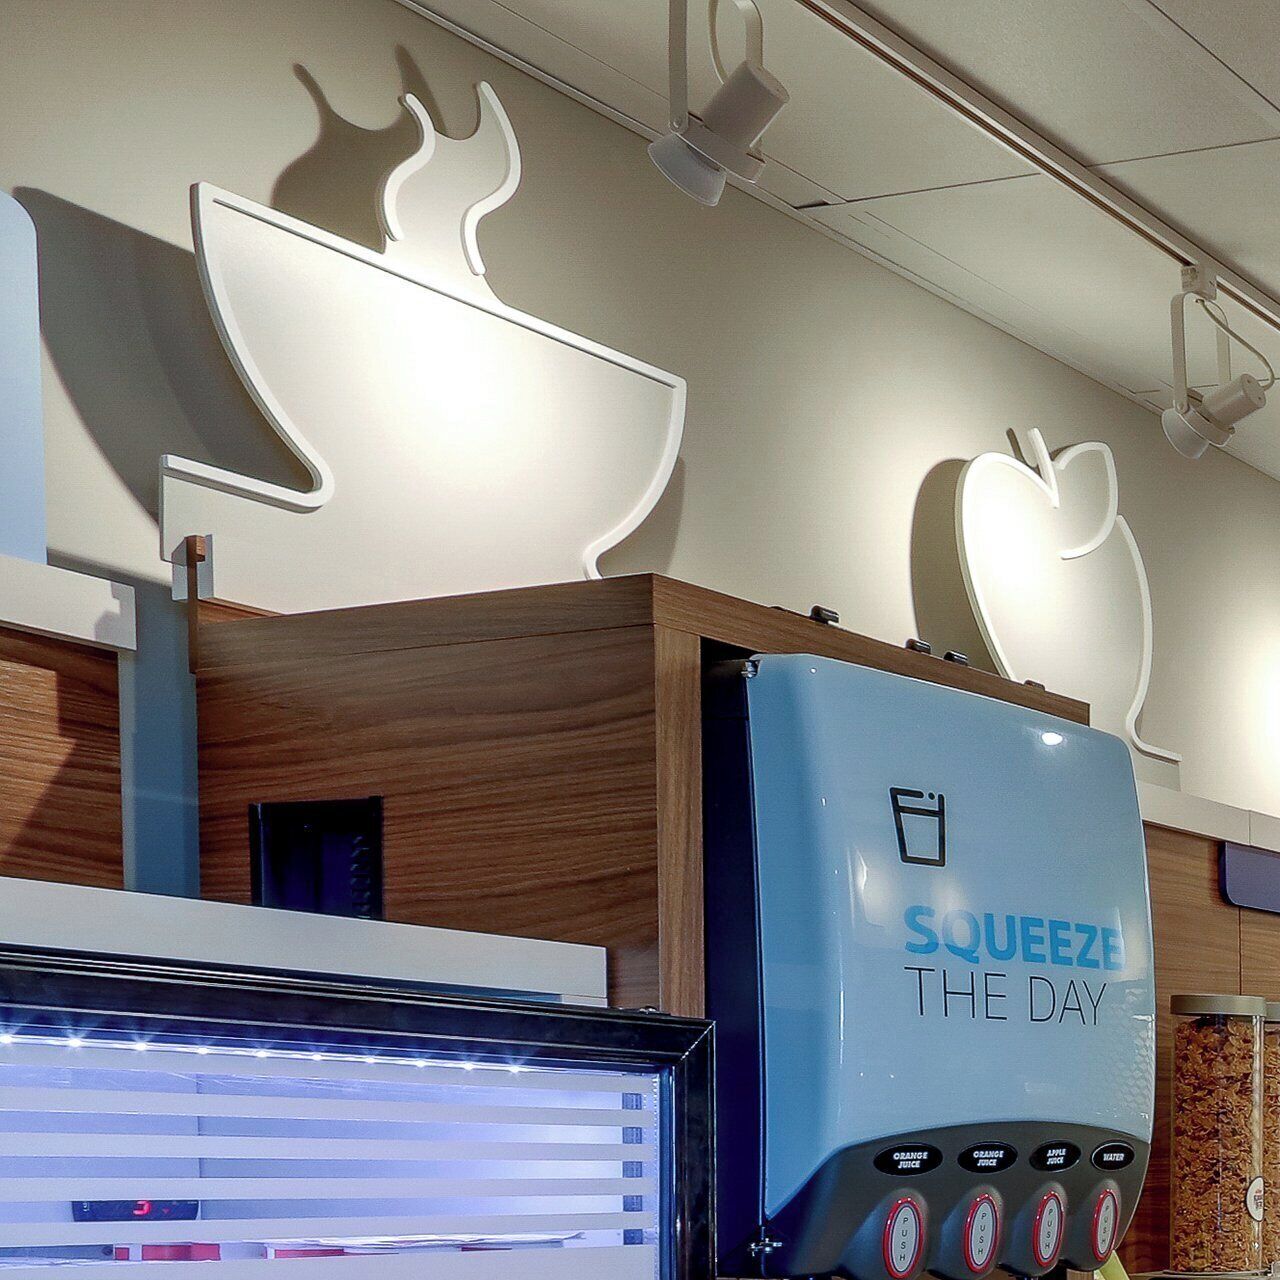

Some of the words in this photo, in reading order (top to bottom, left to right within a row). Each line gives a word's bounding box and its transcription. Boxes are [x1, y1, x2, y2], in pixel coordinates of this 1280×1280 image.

[904, 904, 1127, 971] SQUEEZE
[904, 965, 1008, 1021] THE
[1028, 974, 1108, 1027] DAY
[893, 1151, 929, 1160] ORANGE
[972, 1150, 1004, 1159] ORANGE
[1046, 1148, 1067, 1157] APPLE
[1046, 1157, 1065, 1165] JUICE
[1102, 1153, 1126, 1162] WATER
[897, 1159, 921, 1169] JUICE
[977, 1158, 998, 1167] JUICE
[1044, 1208, 1054, 1249] PUSH
[977, 1212, 987, 1255] PUSH
[899, 1217, 909, 1262] PUSH
